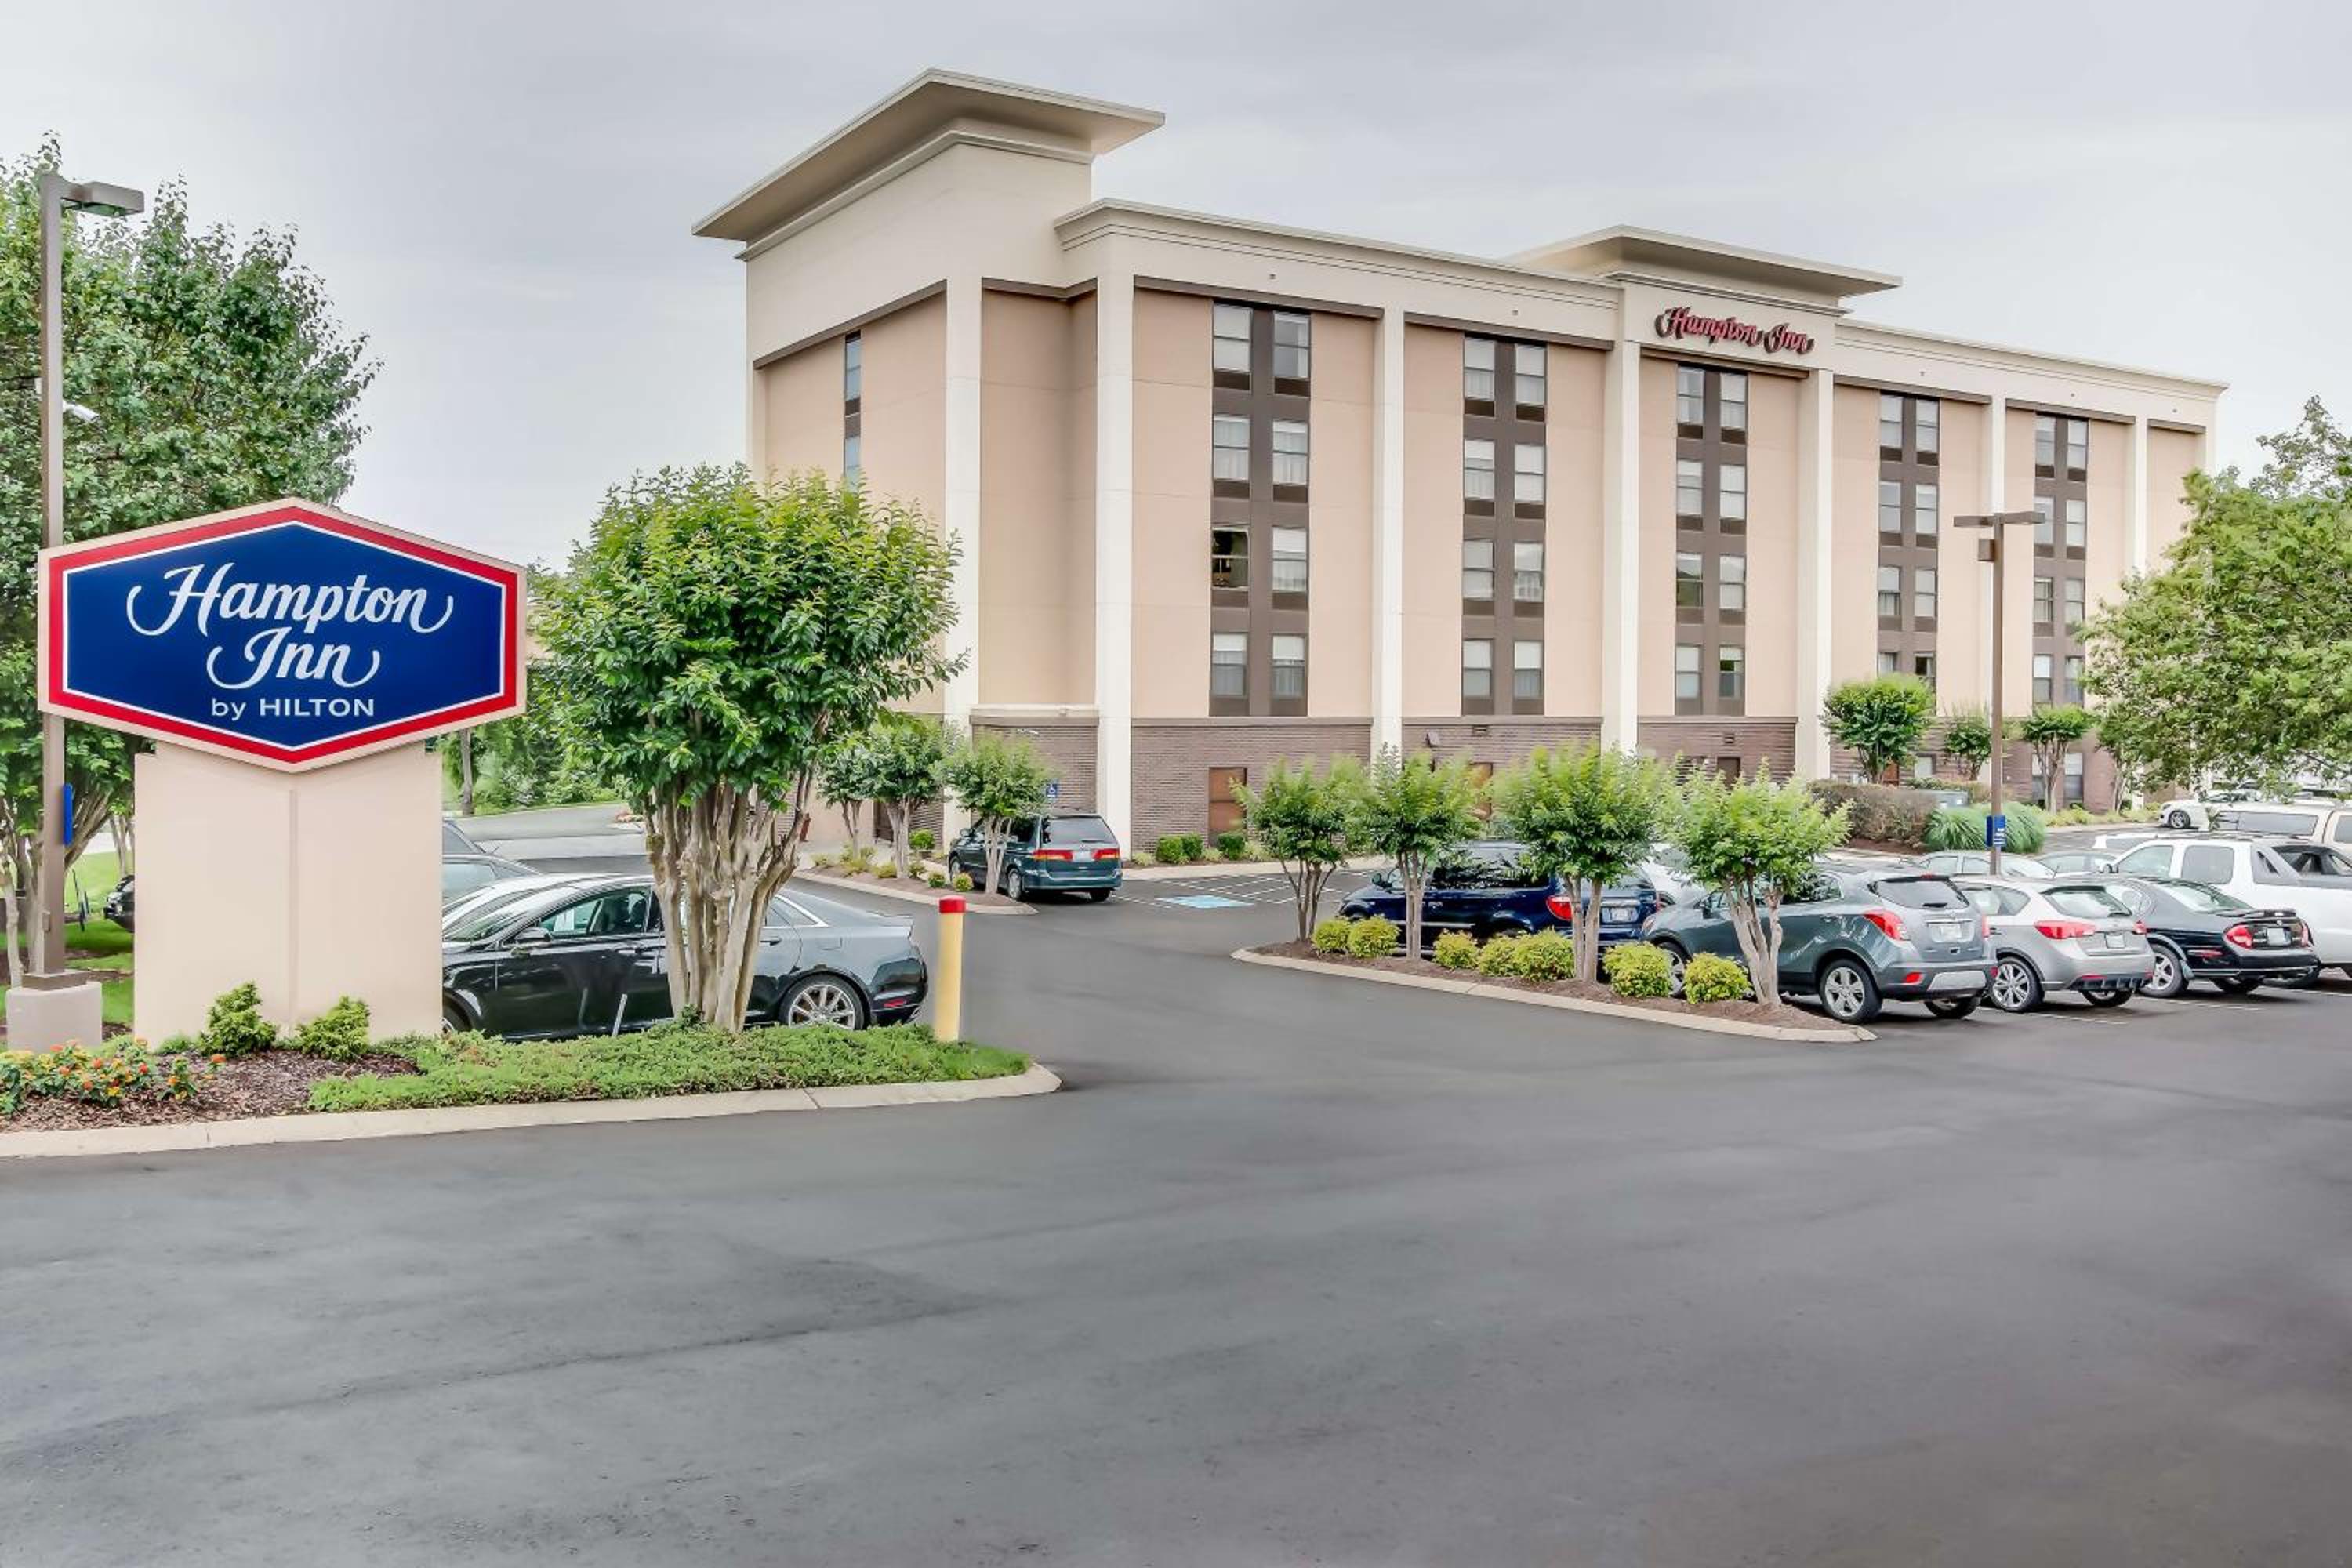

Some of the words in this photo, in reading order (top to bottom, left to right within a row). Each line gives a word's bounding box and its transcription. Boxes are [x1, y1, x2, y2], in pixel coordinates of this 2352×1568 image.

[1654, 306, 1763, 346] Hampton
[1763, 323, 1815, 355] Inn
[126, 562, 454, 637] Hampton
[206, 626, 380, 689] Inn
[212, 698, 246, 720] by
[260, 698, 374, 717] HILTON
